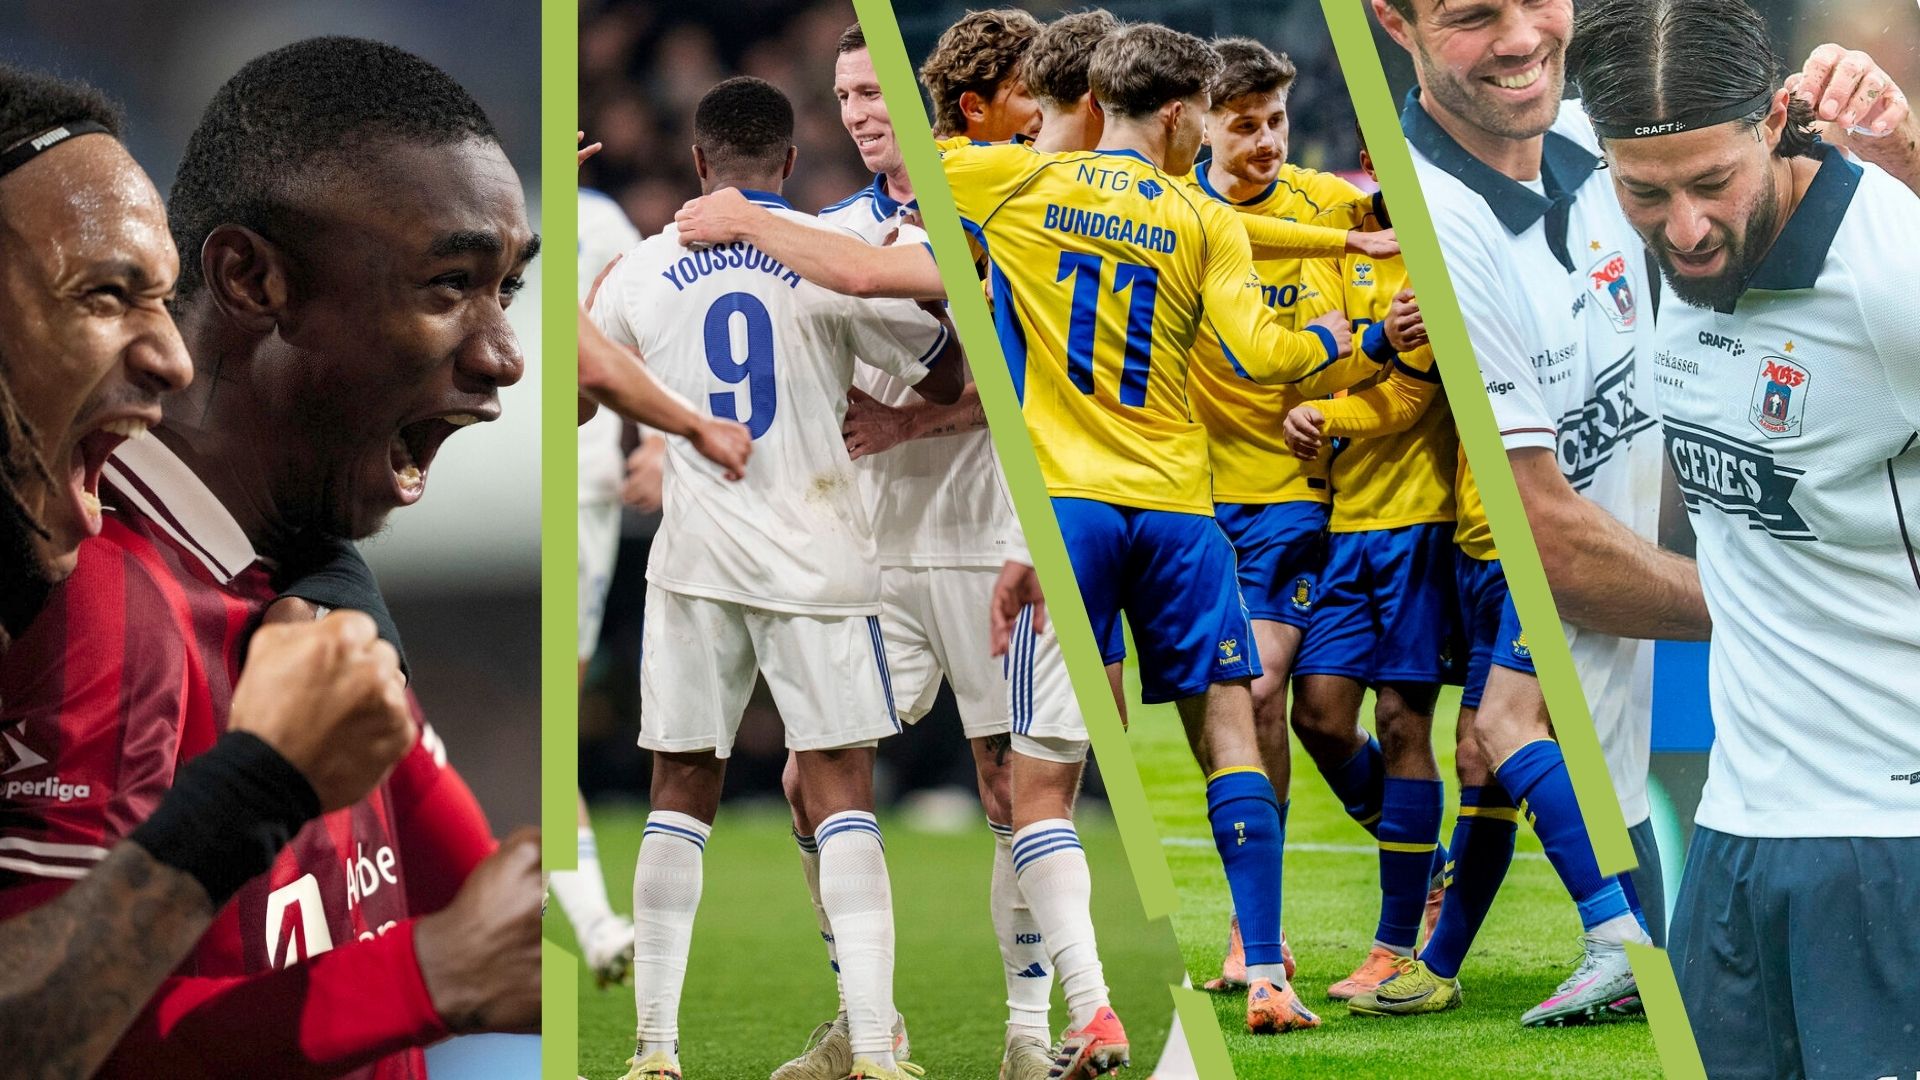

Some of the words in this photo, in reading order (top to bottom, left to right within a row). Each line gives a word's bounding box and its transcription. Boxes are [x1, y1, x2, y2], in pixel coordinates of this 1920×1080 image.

[31, 127, 71, 151] PUMA
[1634, 123, 1674, 135] CRAFT
[1076, 164, 1129, 191] NTG
[1043, 203, 1177, 254] BUNDGAARD
[1056, 250, 1159, 408] 11
[1698, 331, 1735, 352] CRAFT
[703, 291, 777, 441] 9
[1672, 437, 1762, 504] CERES
